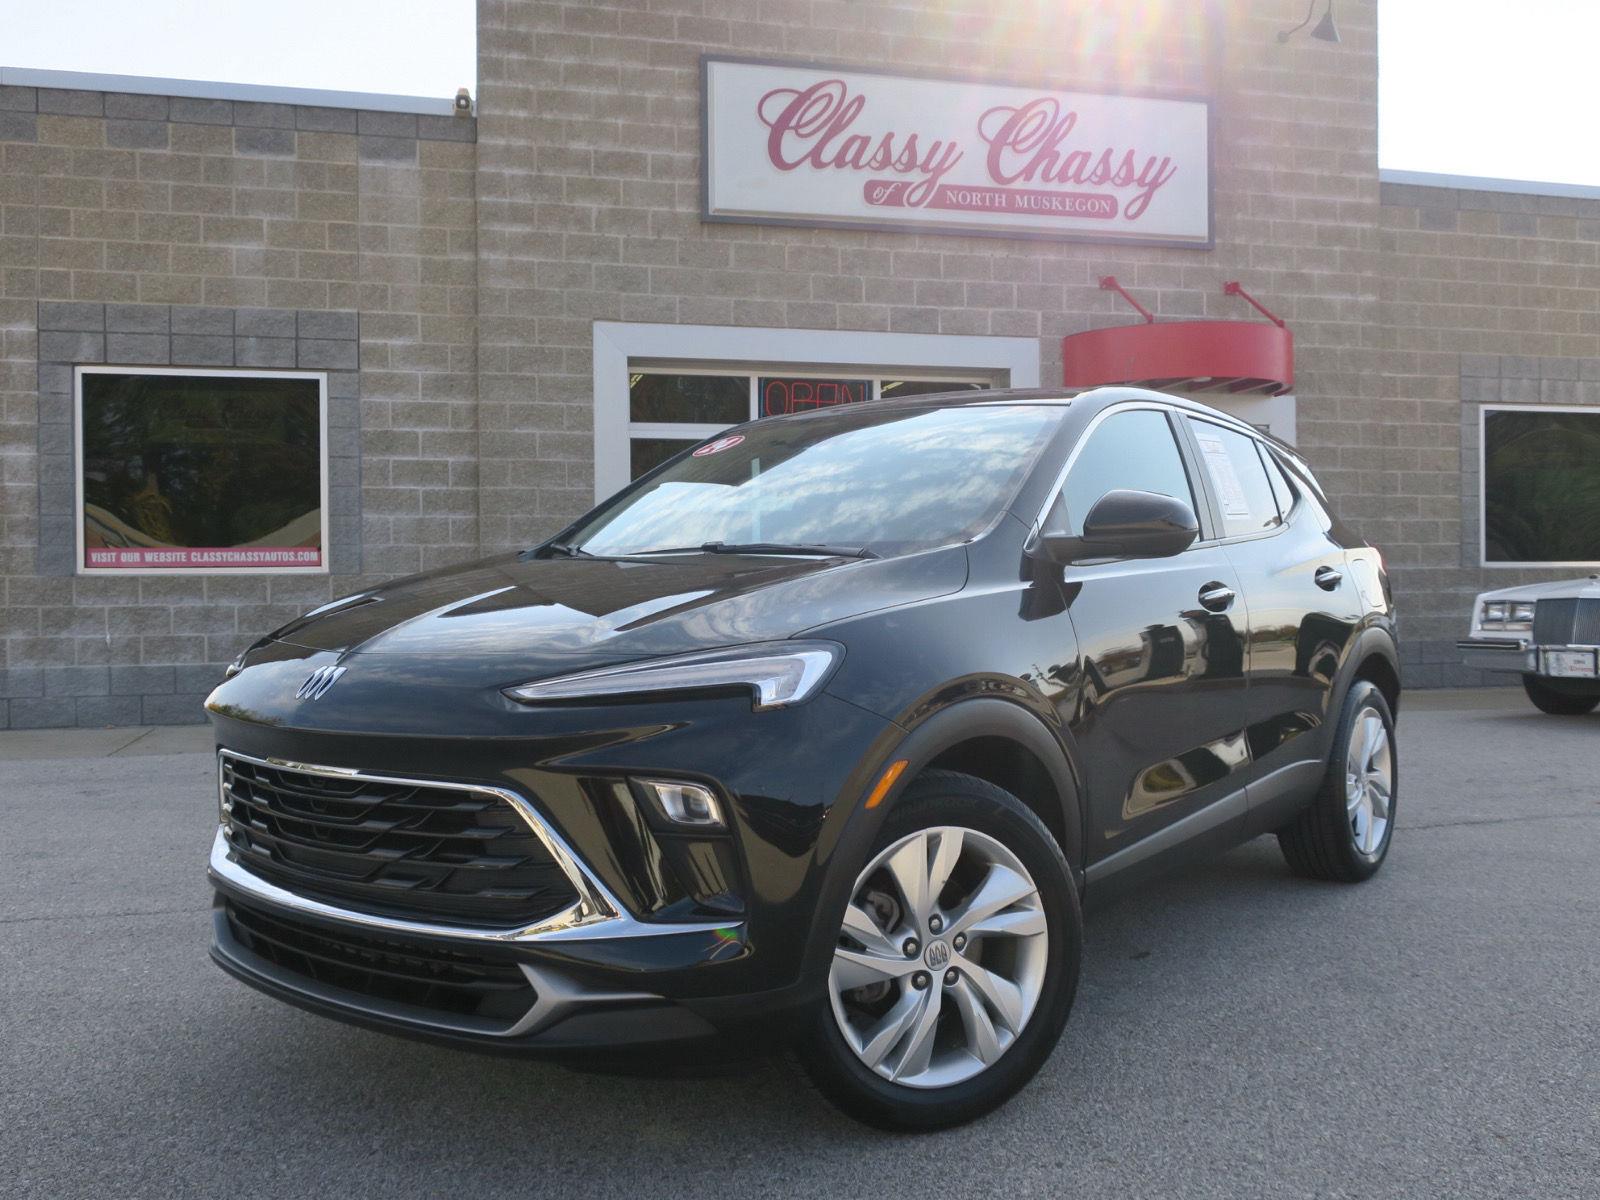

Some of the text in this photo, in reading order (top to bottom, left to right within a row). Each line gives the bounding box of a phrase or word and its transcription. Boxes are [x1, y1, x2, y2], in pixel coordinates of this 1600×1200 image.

[757, 79, 1178, 221] Classy Chassy
[873, 183, 1112, 214] of NORTH MUSKEGON
[91, 551, 318, 562] VISIT OUR WEBSITE CLASSYCHASSYAUTOS.COM
